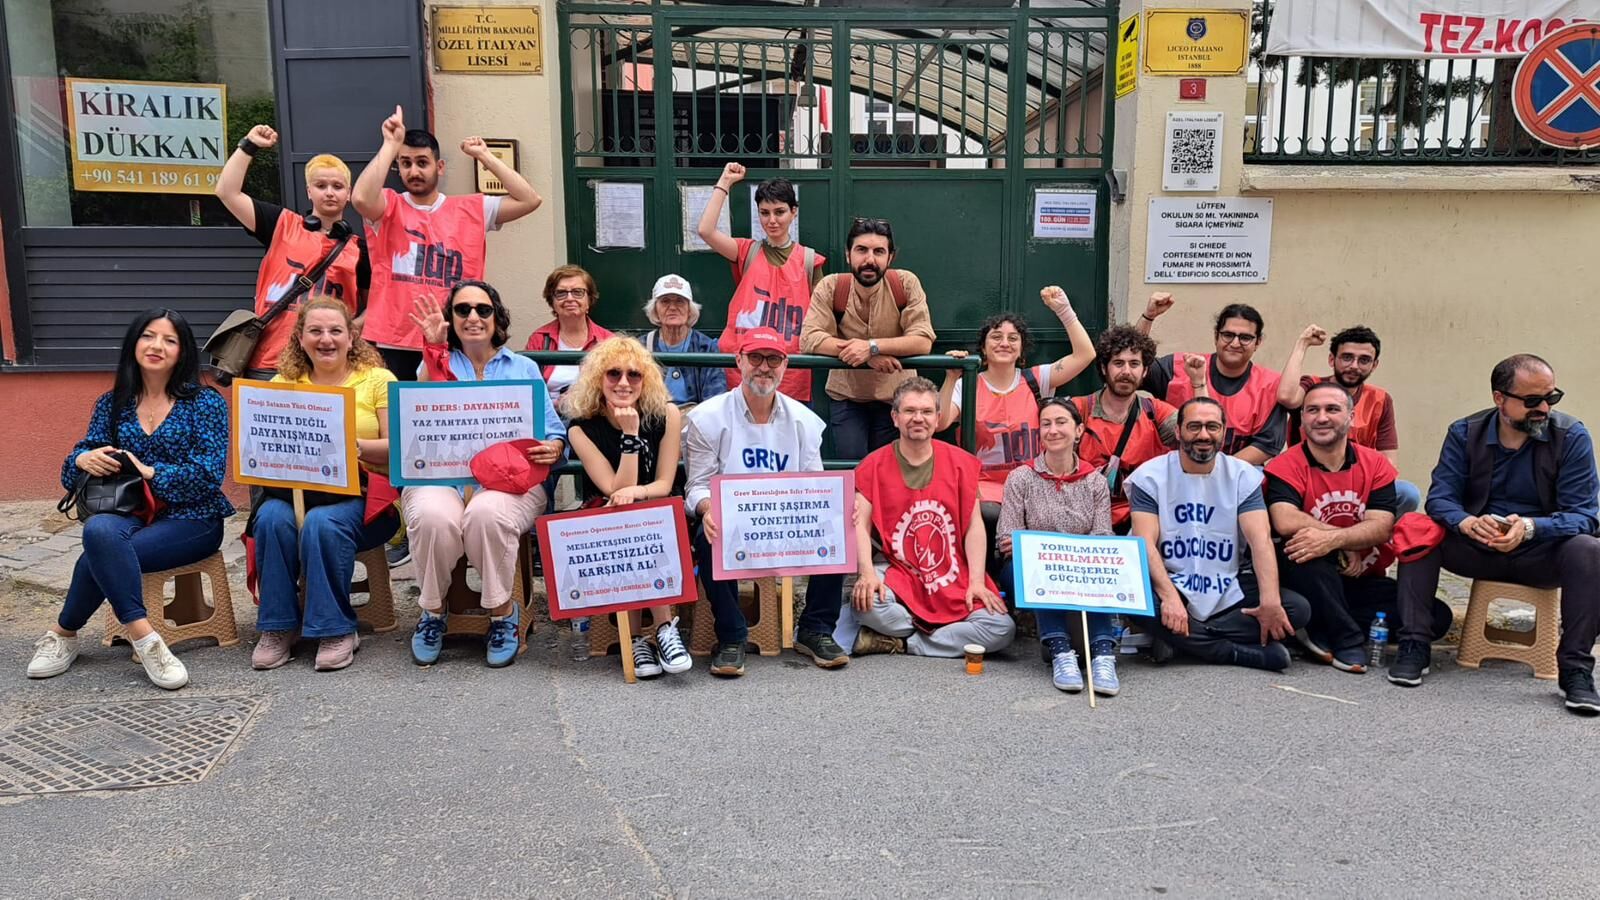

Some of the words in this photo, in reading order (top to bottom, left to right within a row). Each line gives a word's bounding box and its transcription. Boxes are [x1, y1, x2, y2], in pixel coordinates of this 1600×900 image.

[475, 14, 497, 24] T.C.
[493, 25, 535, 34] BAKANLIĞI
[1420, 13, 1587, 53] TEZ-KO
[437, 36, 474, 50] ÖZEL
[477, 37, 536, 50] İTALYAN
[468, 53, 508, 66] LİSESİ
[1190, 82, 1198, 95] 3
[79, 86, 220, 121] KİRALIK
[81, 126, 221, 161] DÜKKAN
[80, 169, 112, 184] +90
[116, 170, 144, 185] 541
[152, 171, 178, 186] 189
[183, 172, 200, 187] 61
[1196, 201, 1226, 209] LÜTFEN
[1176, 220, 1204, 228] SİGARA
[1205, 220, 1244, 230] İÇMEYİNİZ
[1206, 260, 1252, 268] PROSSIMITÀ
[415, 404, 429, 412] BU
[431, 403, 462, 412] DERS:
[464, 402, 520, 412] DAYANIŞMA
[253, 413, 292, 426] SINIFTA
[295, 416, 327, 428] DEĞİL
[412, 419, 432, 428] YAZ
[434, 418, 480, 427] TAHTAYA
[482, 416, 524, 425] UNUTMA
[250, 426, 332, 444] DAYANIŞMADA
[418, 434, 447, 442] GREV
[450, 433, 484, 442] KIRICI
[486, 431, 518, 440] OLMA!
[260, 440, 302, 454] YERİNİ
[304, 446, 322, 456] AL!
[738, 502, 777, 512] SAFINI
[780, 500, 830, 512] ŞAŞIRMA
[1174, 502, 1216, 524] GREV
[751, 514, 818, 527] YÖNETİMİN
[744, 530, 784, 542] SOPASI
[787, 528, 825, 539] OLMA!
[566, 537, 632, 552] MESLEKTAŞINI
[634, 532, 663, 544] DEĞİL
[1040, 543, 1119, 554] YORULMAYIZ
[568, 544, 665, 565] ADALETSİZLİĞİ
[1038, 552, 1125, 566] KIRILMAYIZ
[578, 563, 634, 578] KARŞINA
[637, 560, 658, 570] AL!
[1044, 563, 1120, 576] BİRLEŞEREK
[1049, 574, 1118, 585] GÜÇLÜYÜZ!
